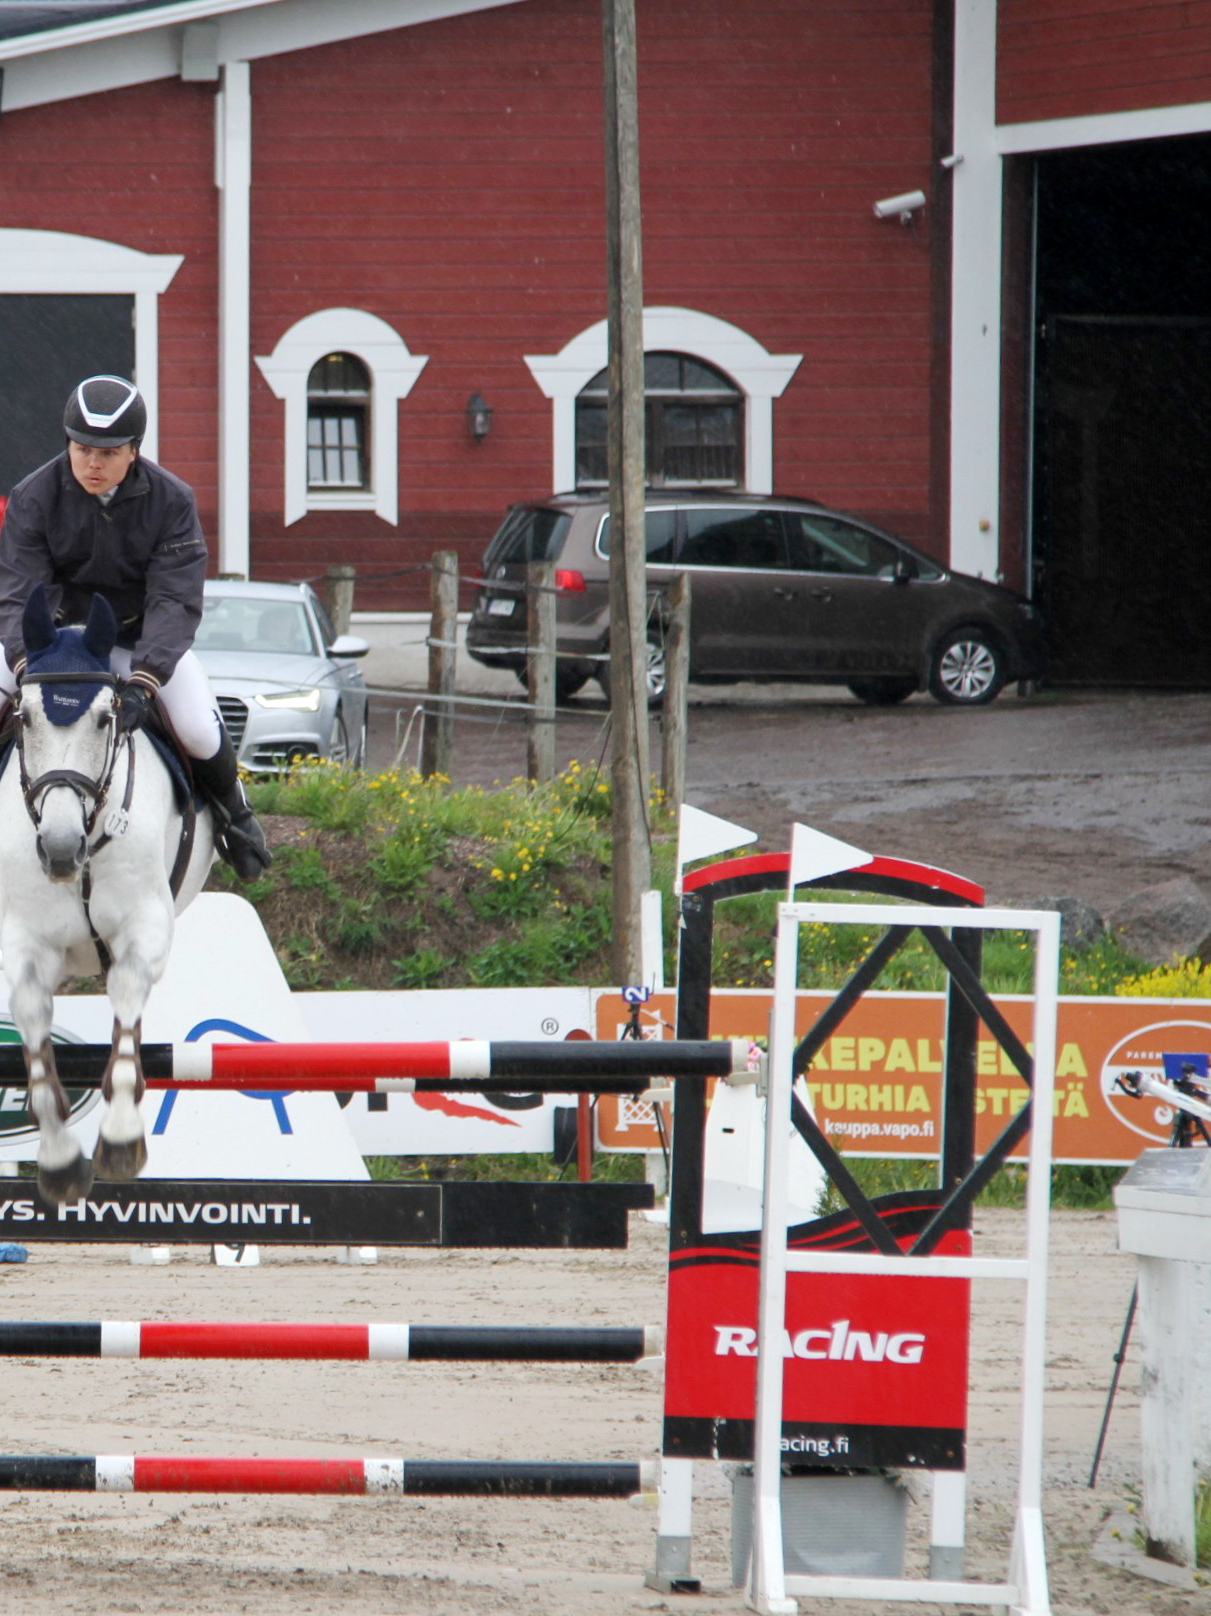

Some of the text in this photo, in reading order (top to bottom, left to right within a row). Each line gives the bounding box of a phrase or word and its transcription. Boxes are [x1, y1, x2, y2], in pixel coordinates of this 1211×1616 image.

[107, 813, 129, 835] 173
[823, 1118, 935, 1139] kauppa.vapo.fi
[779, 1434, 850, 1457] acing.fi
